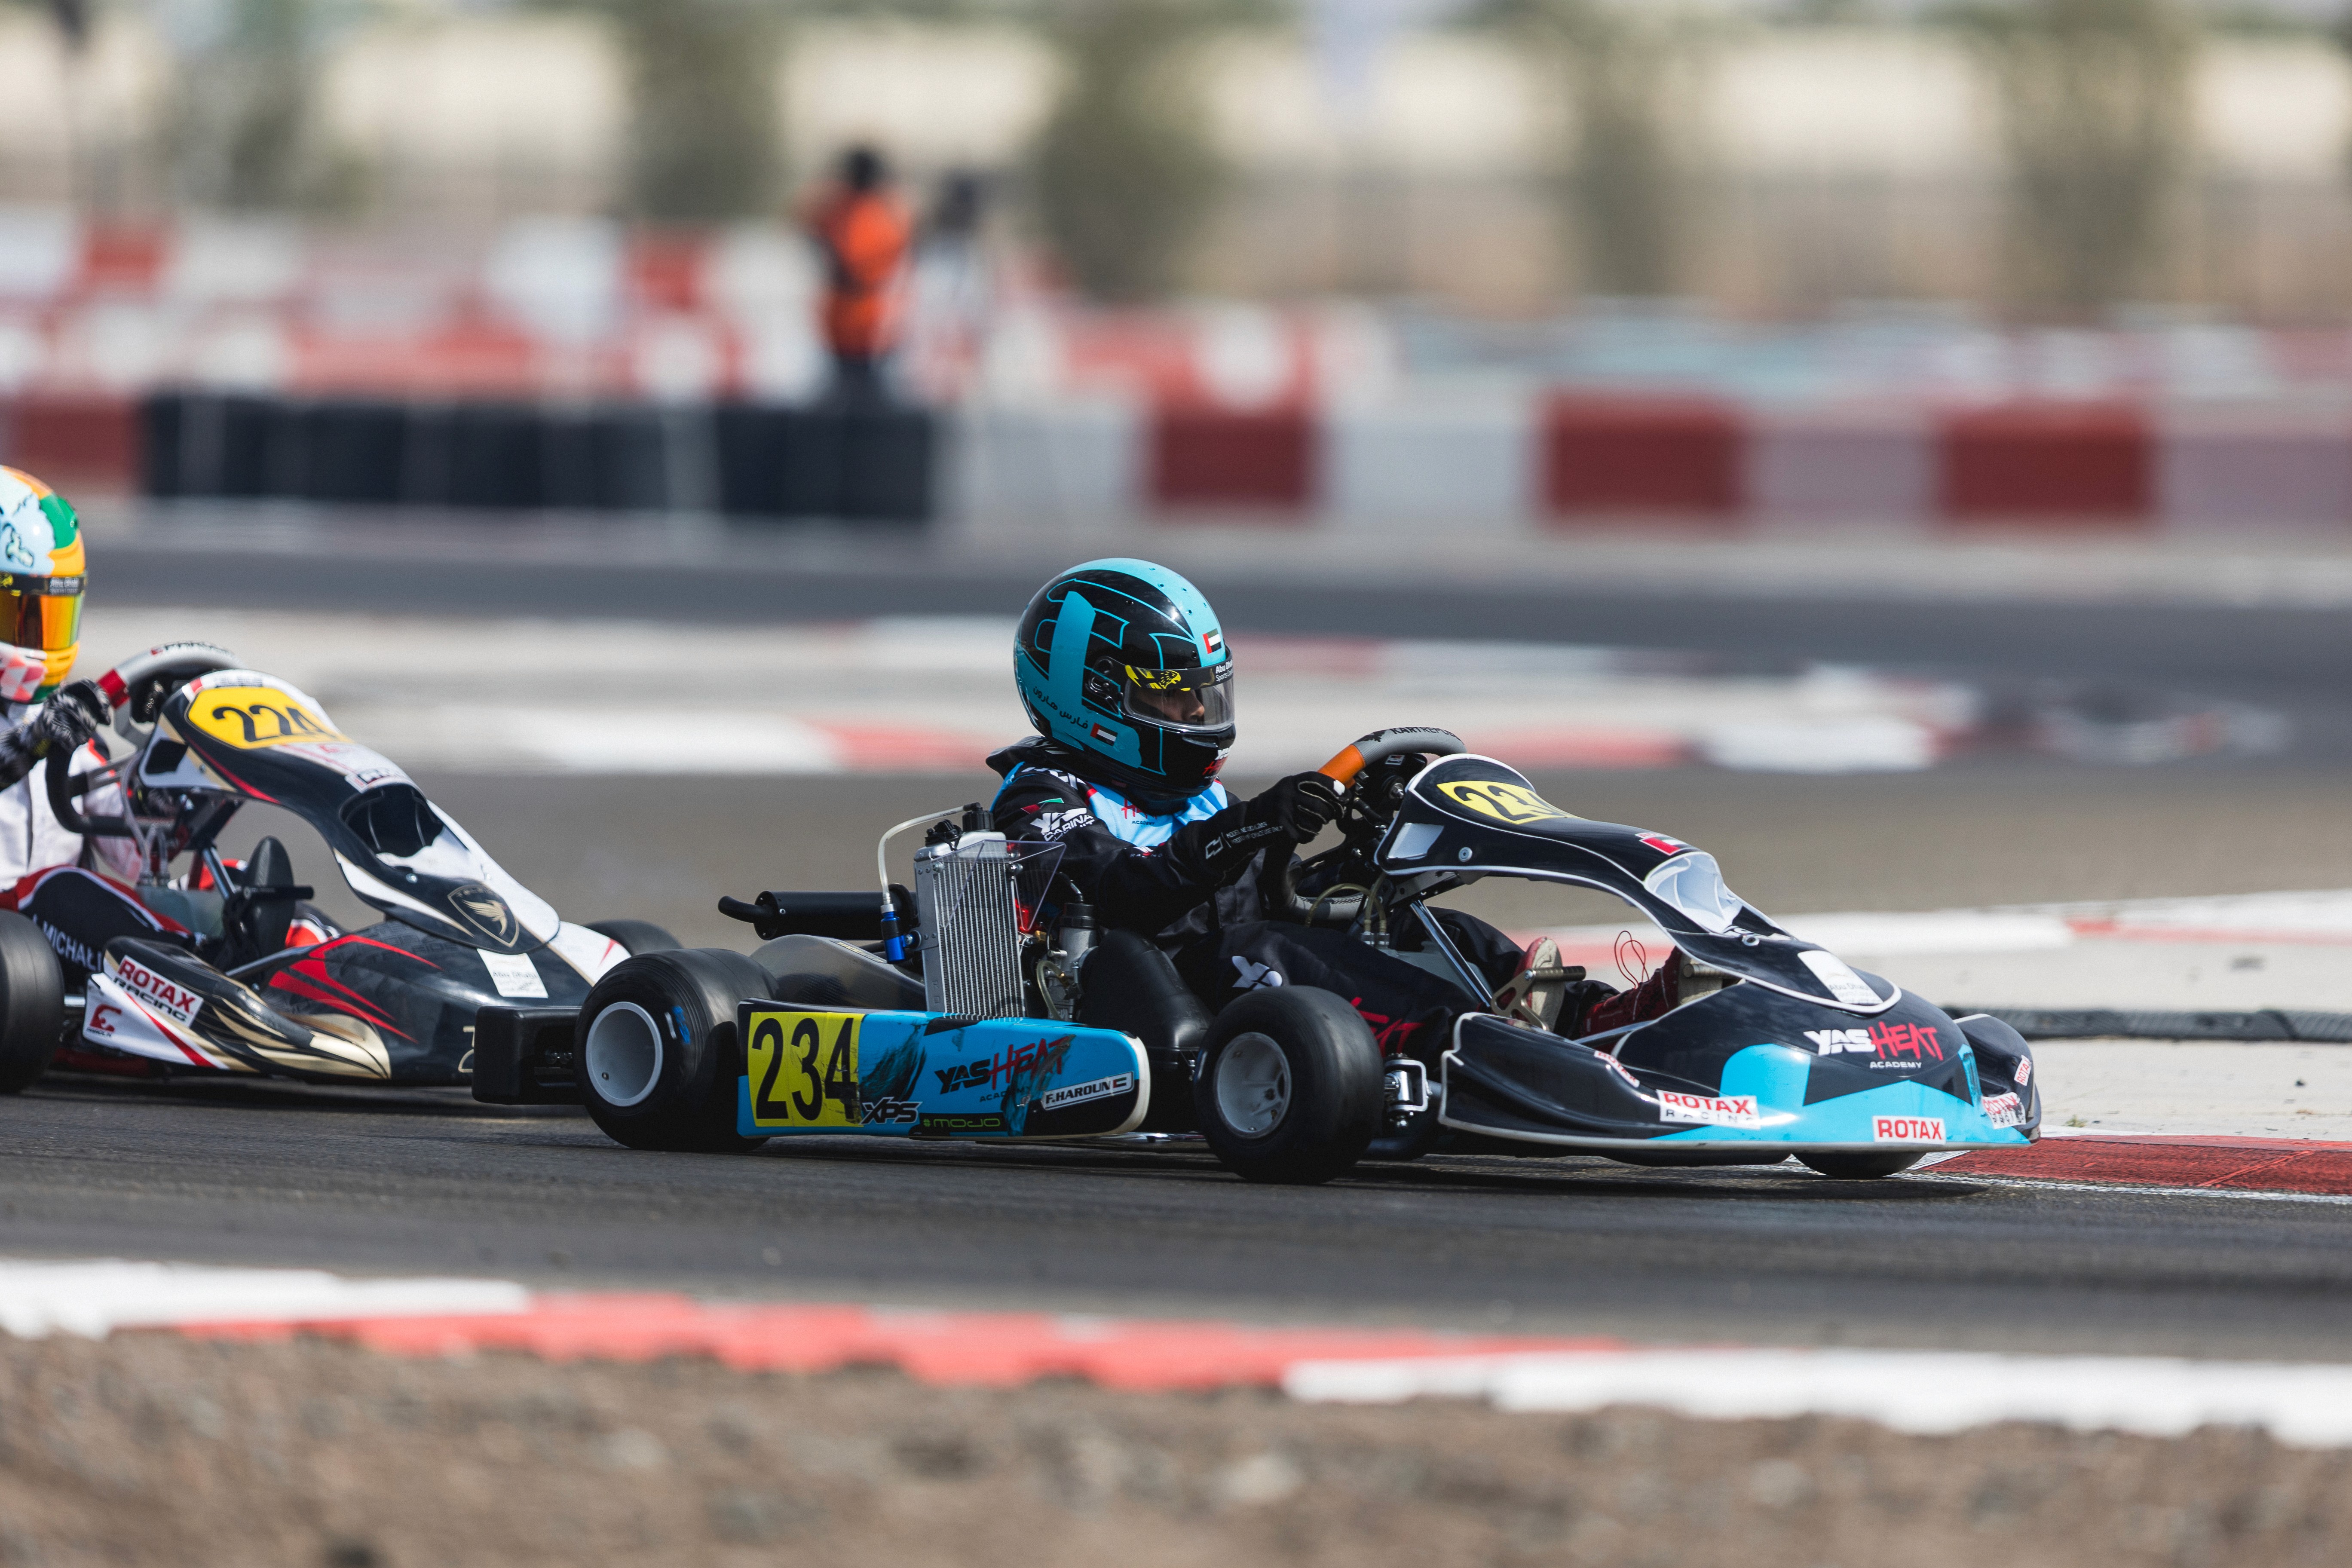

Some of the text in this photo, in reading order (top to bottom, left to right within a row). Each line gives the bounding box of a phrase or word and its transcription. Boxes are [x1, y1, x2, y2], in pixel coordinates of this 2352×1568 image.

[1216, 665, 1226, 674] Abu
[118, 959, 195, 1013] ROTAX
[752, 1017, 858, 1121] 234
[1045, 1080, 1111, 1104] F.HAROUN
[1663, 1092, 1752, 1115] ROTAX
[859, 1096, 923, 1125] XPS
[1878, 1119, 1942, 1139] ROTAX
